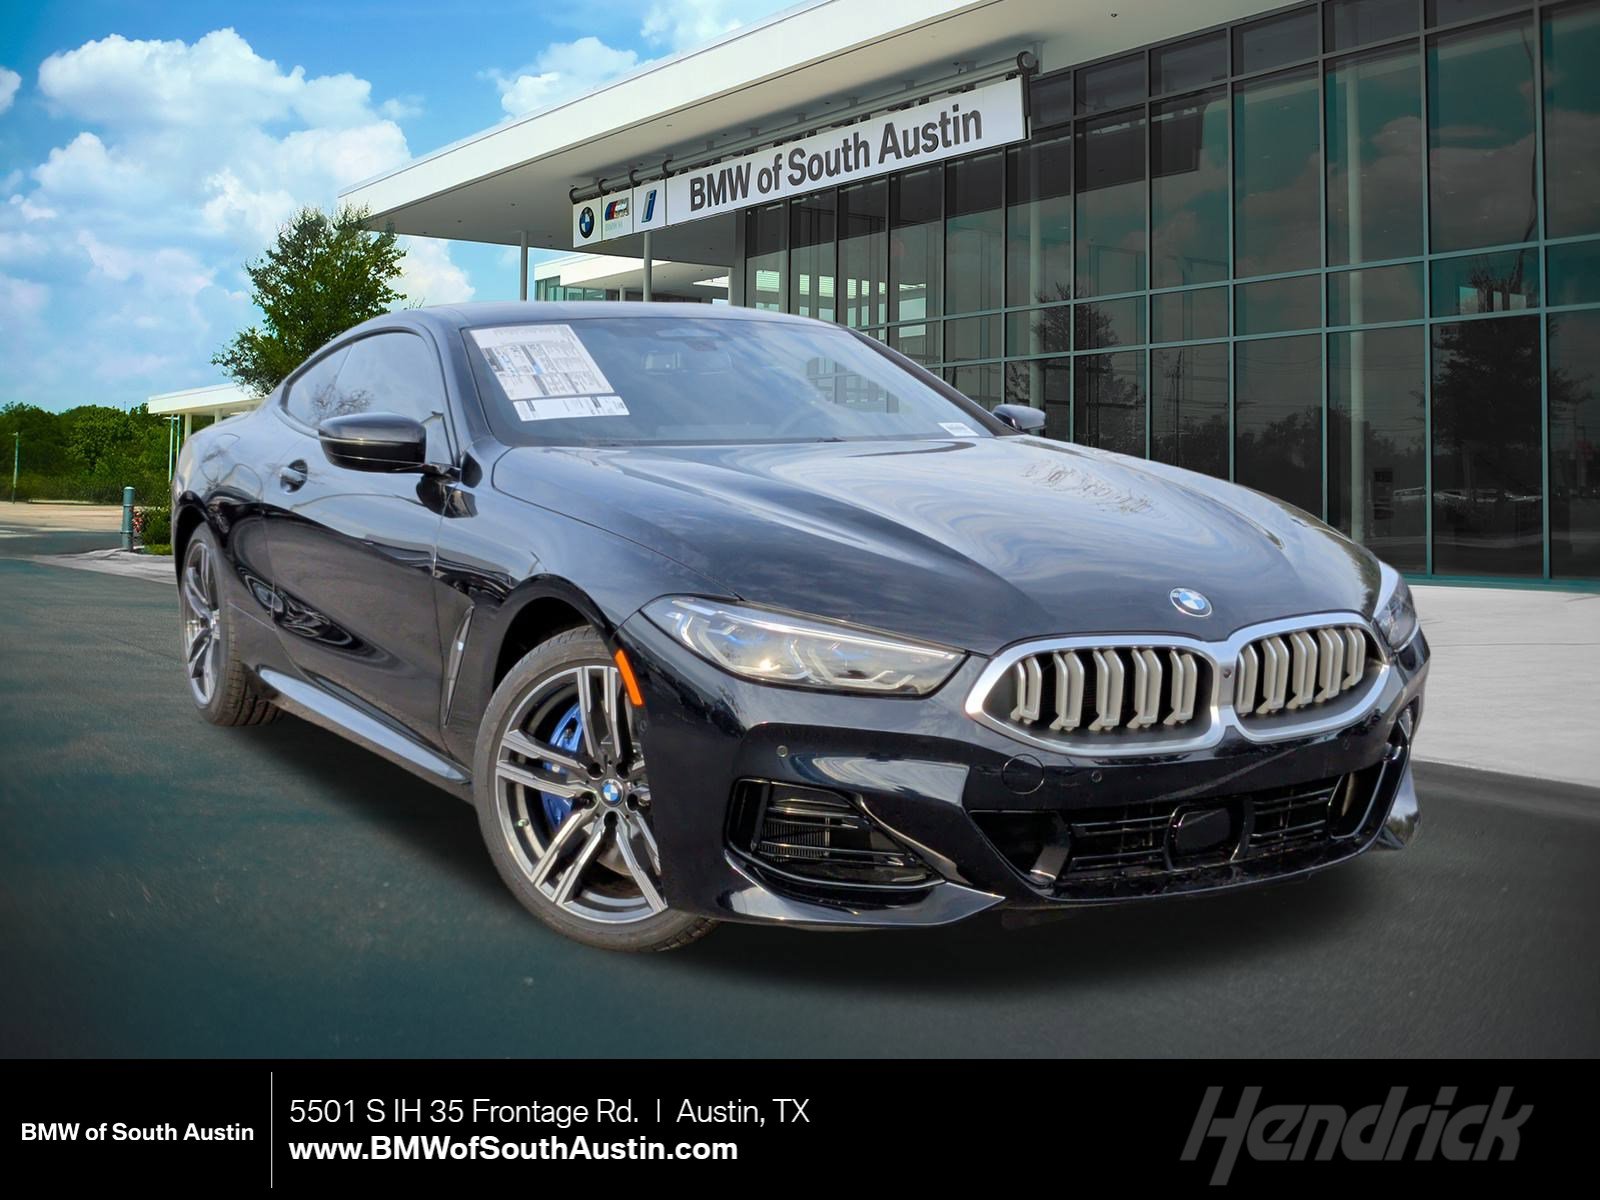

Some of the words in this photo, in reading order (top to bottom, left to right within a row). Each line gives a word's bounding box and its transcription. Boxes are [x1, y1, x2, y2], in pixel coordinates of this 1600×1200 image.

[690, 162, 751, 212] BMW
[757, 153, 782, 194] of
[787, 131, 870, 187] South
[878, 103, 982, 164] Austin
